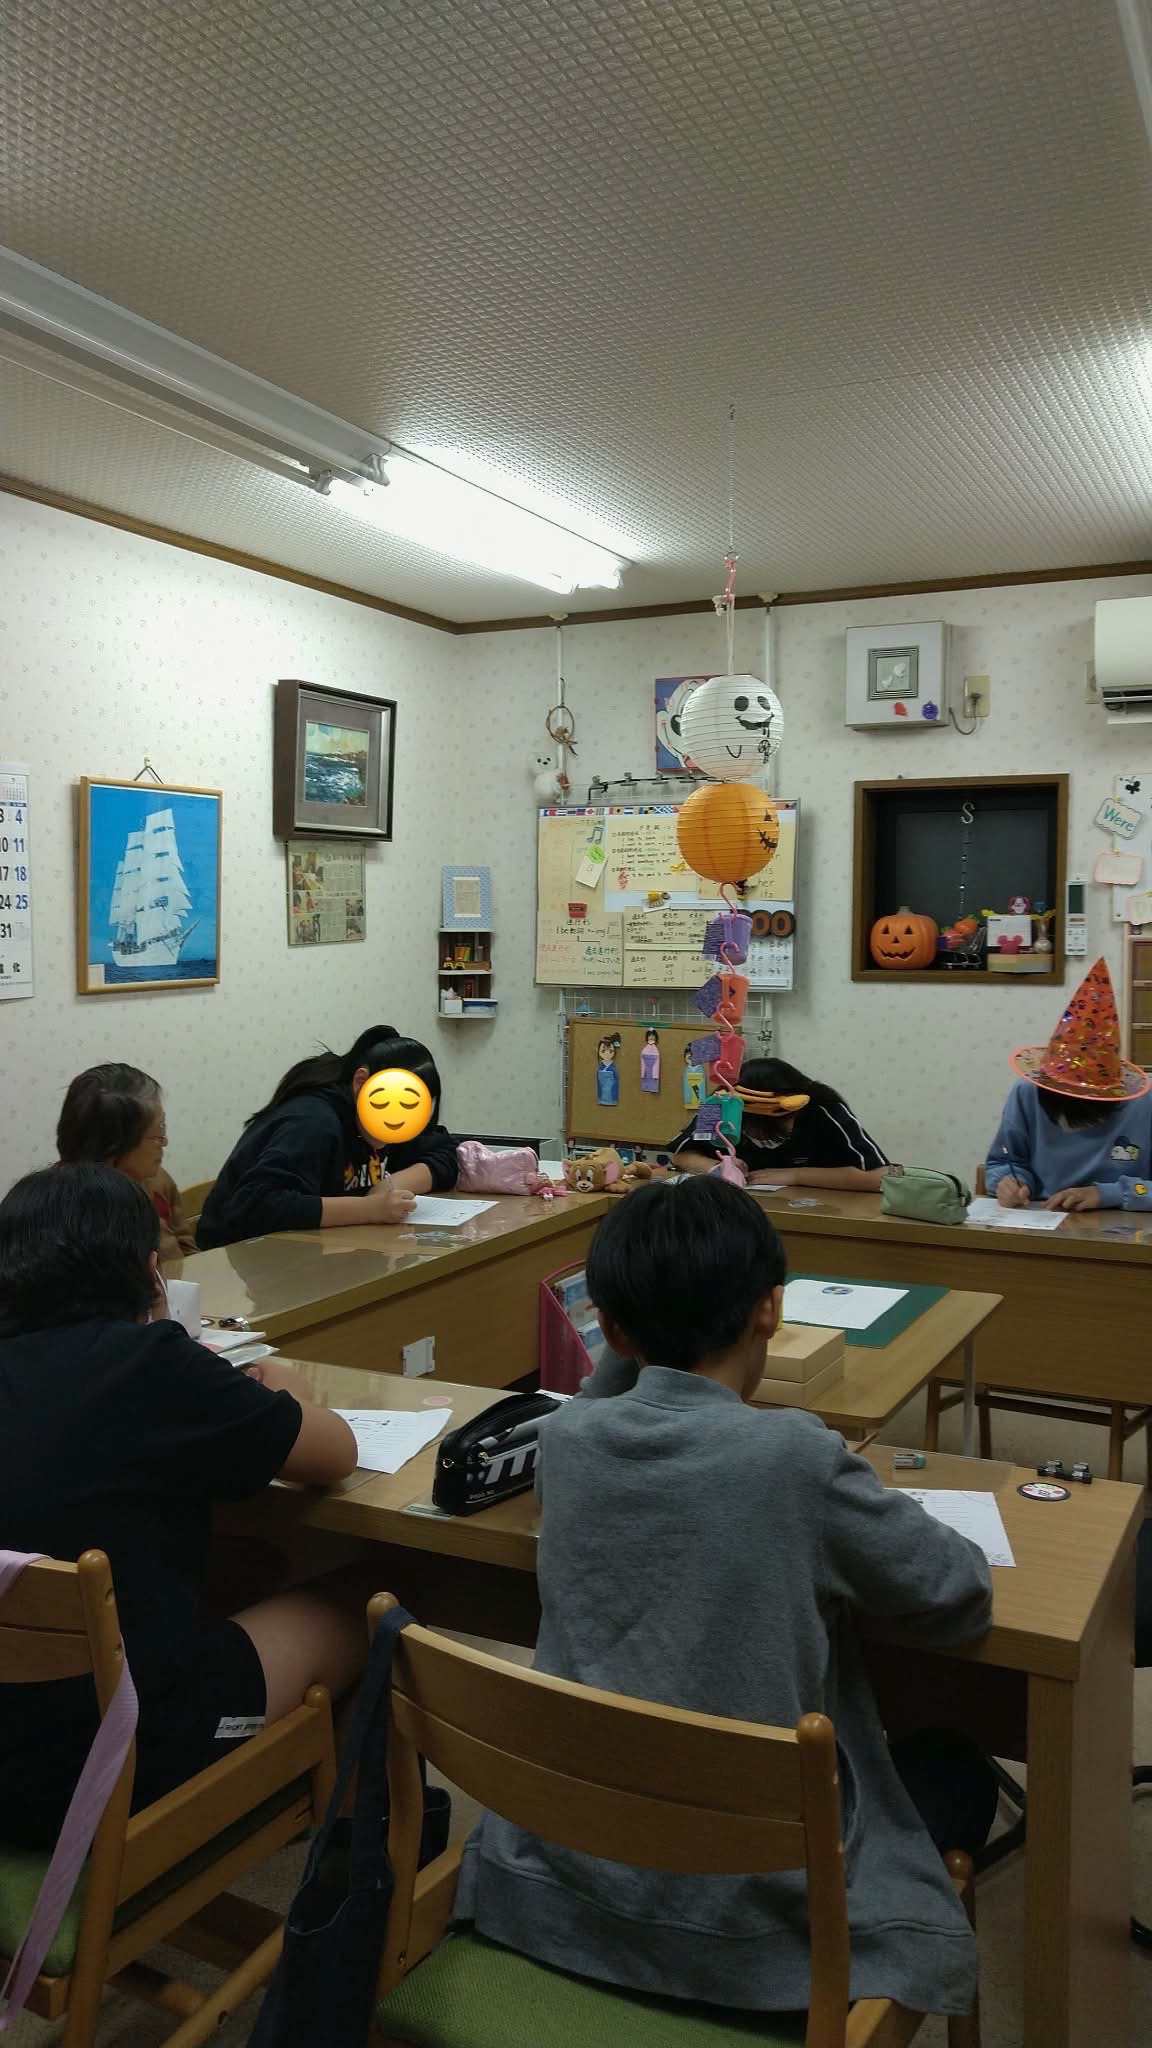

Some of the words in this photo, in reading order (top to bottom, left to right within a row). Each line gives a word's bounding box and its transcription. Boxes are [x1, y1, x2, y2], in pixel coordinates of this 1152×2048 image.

[15, 808, 23, 824] 4
[14, 837, 25, 852] 11
[15, 865, 27, 881] 18
[0, 894, 11, 909] 24
[16, 894, 28, 910] 25
[0, 922, 12, 938] 31
